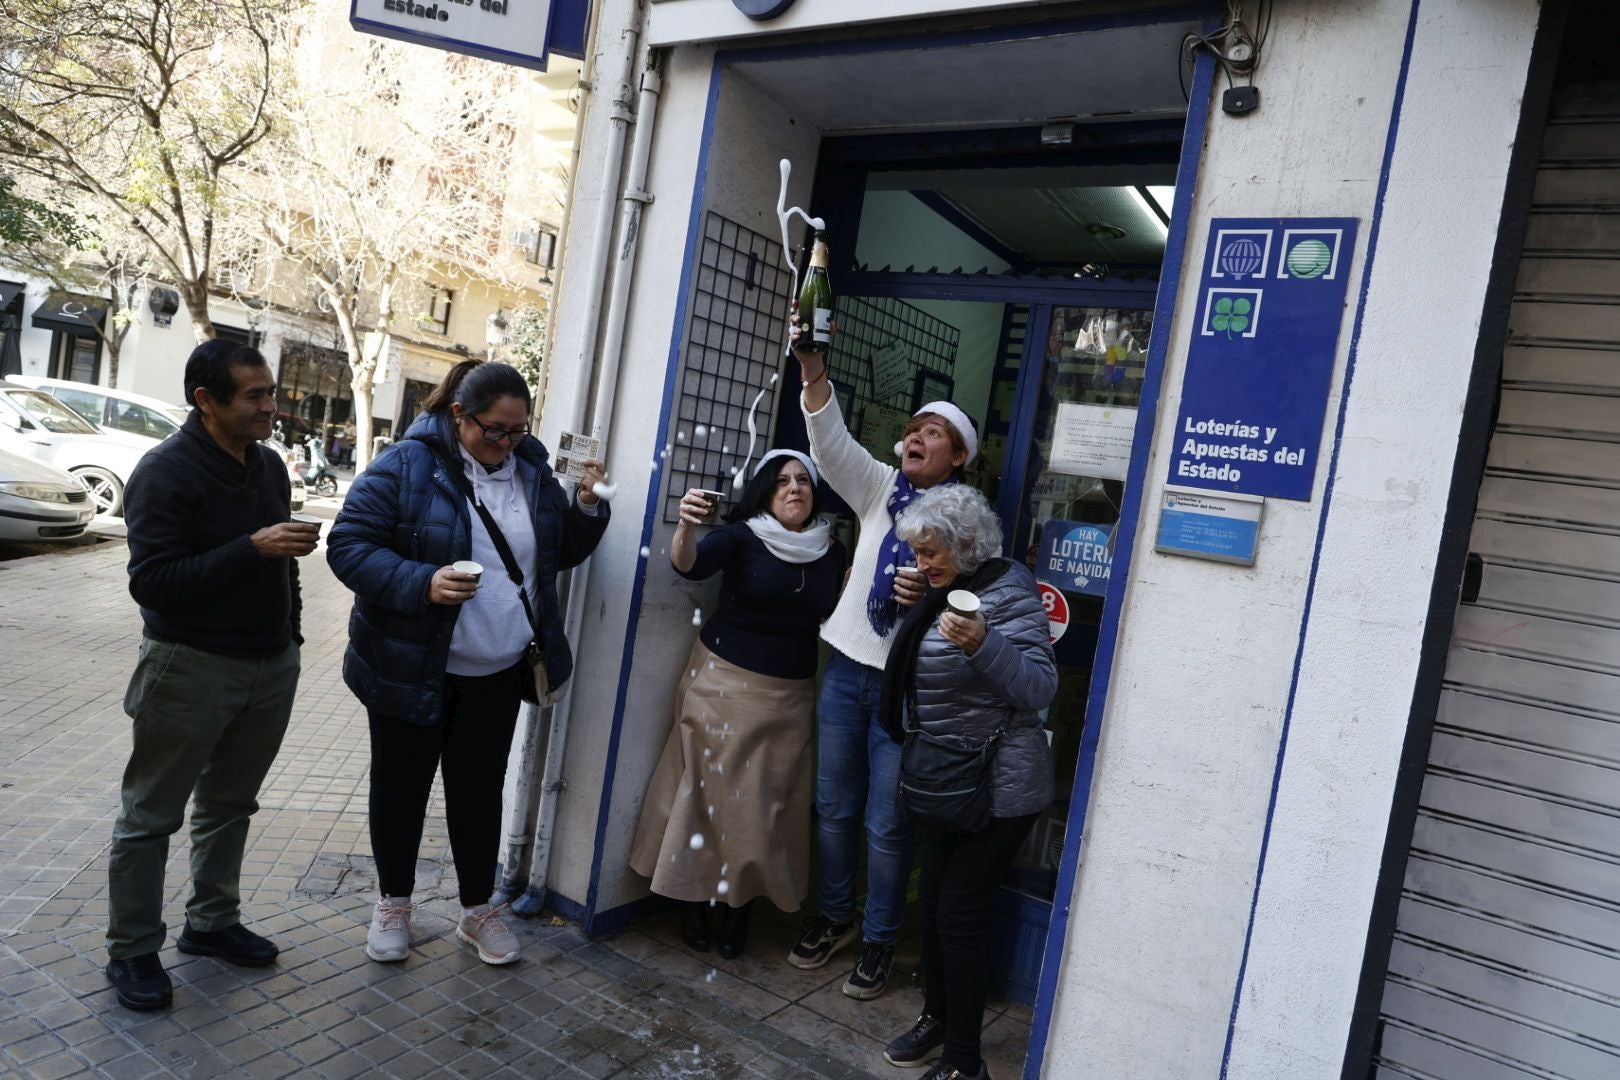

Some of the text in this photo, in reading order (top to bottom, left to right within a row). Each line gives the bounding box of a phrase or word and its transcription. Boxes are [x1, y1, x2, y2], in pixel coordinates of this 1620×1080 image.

[383, 0, 449, 22] Estado
[1185, 417, 1277, 444] Loterías y
[1182, 439, 1306, 466] Apuestas del
[1178, 460, 1241, 482] Estado
[1079, 528, 1099, 541] HAY
[1052, 538, 1113, 565] LOTERI
[1049, 558, 1111, 579] DE NAVIDA
